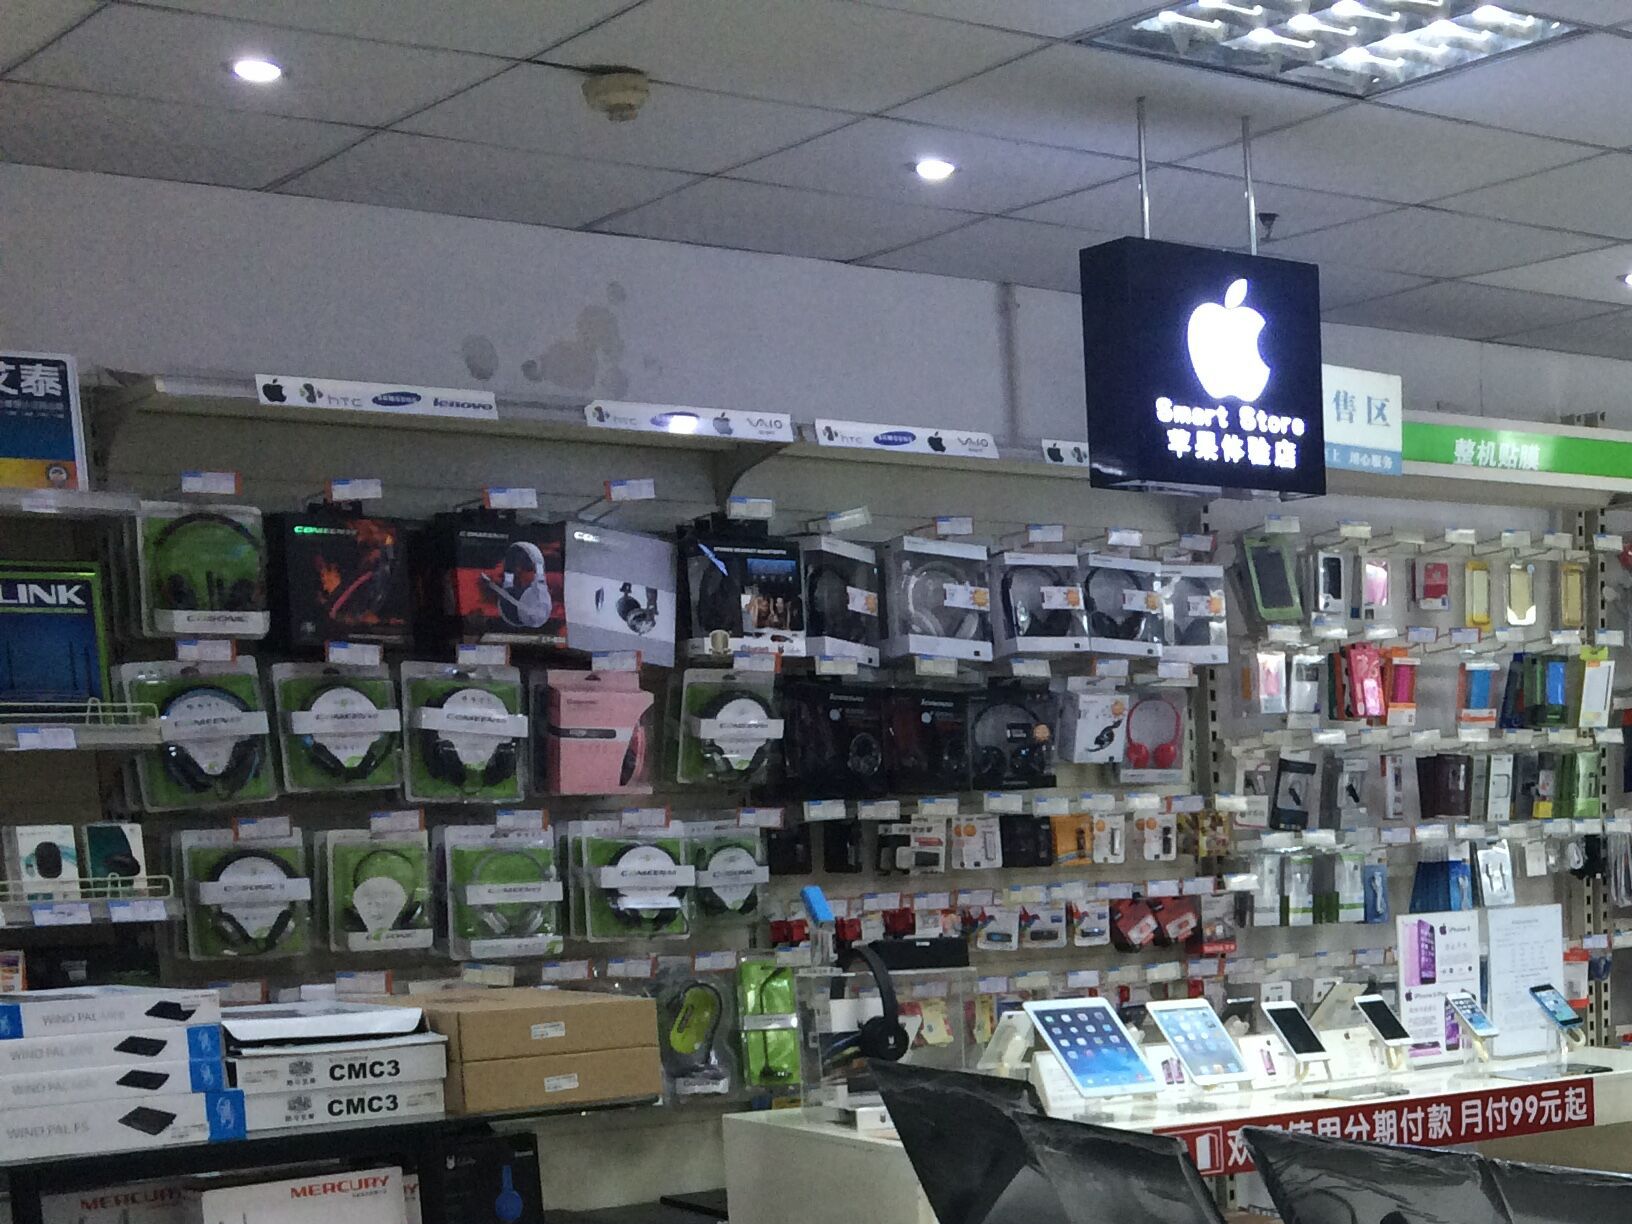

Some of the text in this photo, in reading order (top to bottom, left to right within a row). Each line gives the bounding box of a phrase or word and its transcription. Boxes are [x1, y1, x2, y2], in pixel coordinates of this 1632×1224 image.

[433, 397, 493, 411] lenovo
[1156, 397, 1305, 436] Smart Store
[1333, 390, 1390, 427] 售区
[1166, 428, 1297, 469] 苹果体验店
[328, 1059, 401, 1082] CMC3
[327, 1093, 399, 1117] CMC3
[1458, 1083, 1588, 1137] 月付99元起
[7, 1123, 45, 1139] WIND
[1227, 1102, 1453, 1168] 欢用分期付款
[290, 1175, 390, 1200] MERCURY
